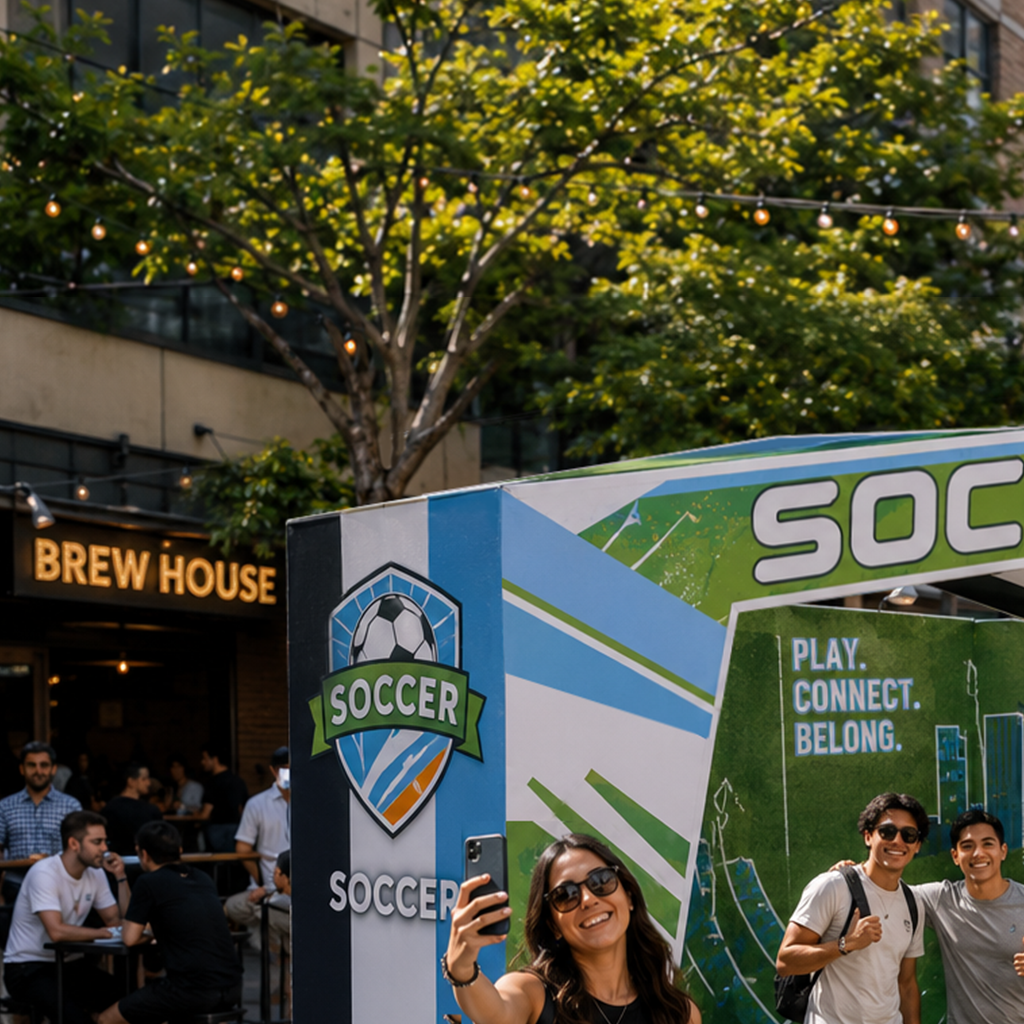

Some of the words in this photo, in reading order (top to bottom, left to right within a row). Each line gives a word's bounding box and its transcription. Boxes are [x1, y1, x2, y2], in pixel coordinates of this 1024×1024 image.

[34, 537, 150, 591] BREW
[158, 554, 277, 605] HOUSE
[792, 637, 867, 672] PLAY.
[329, 673, 459, 726] SOCCER
[792, 678, 921, 713] CONNECT.
[794, 720, 902, 756] BELONG.
[329, 870, 460, 920] SOCCER
